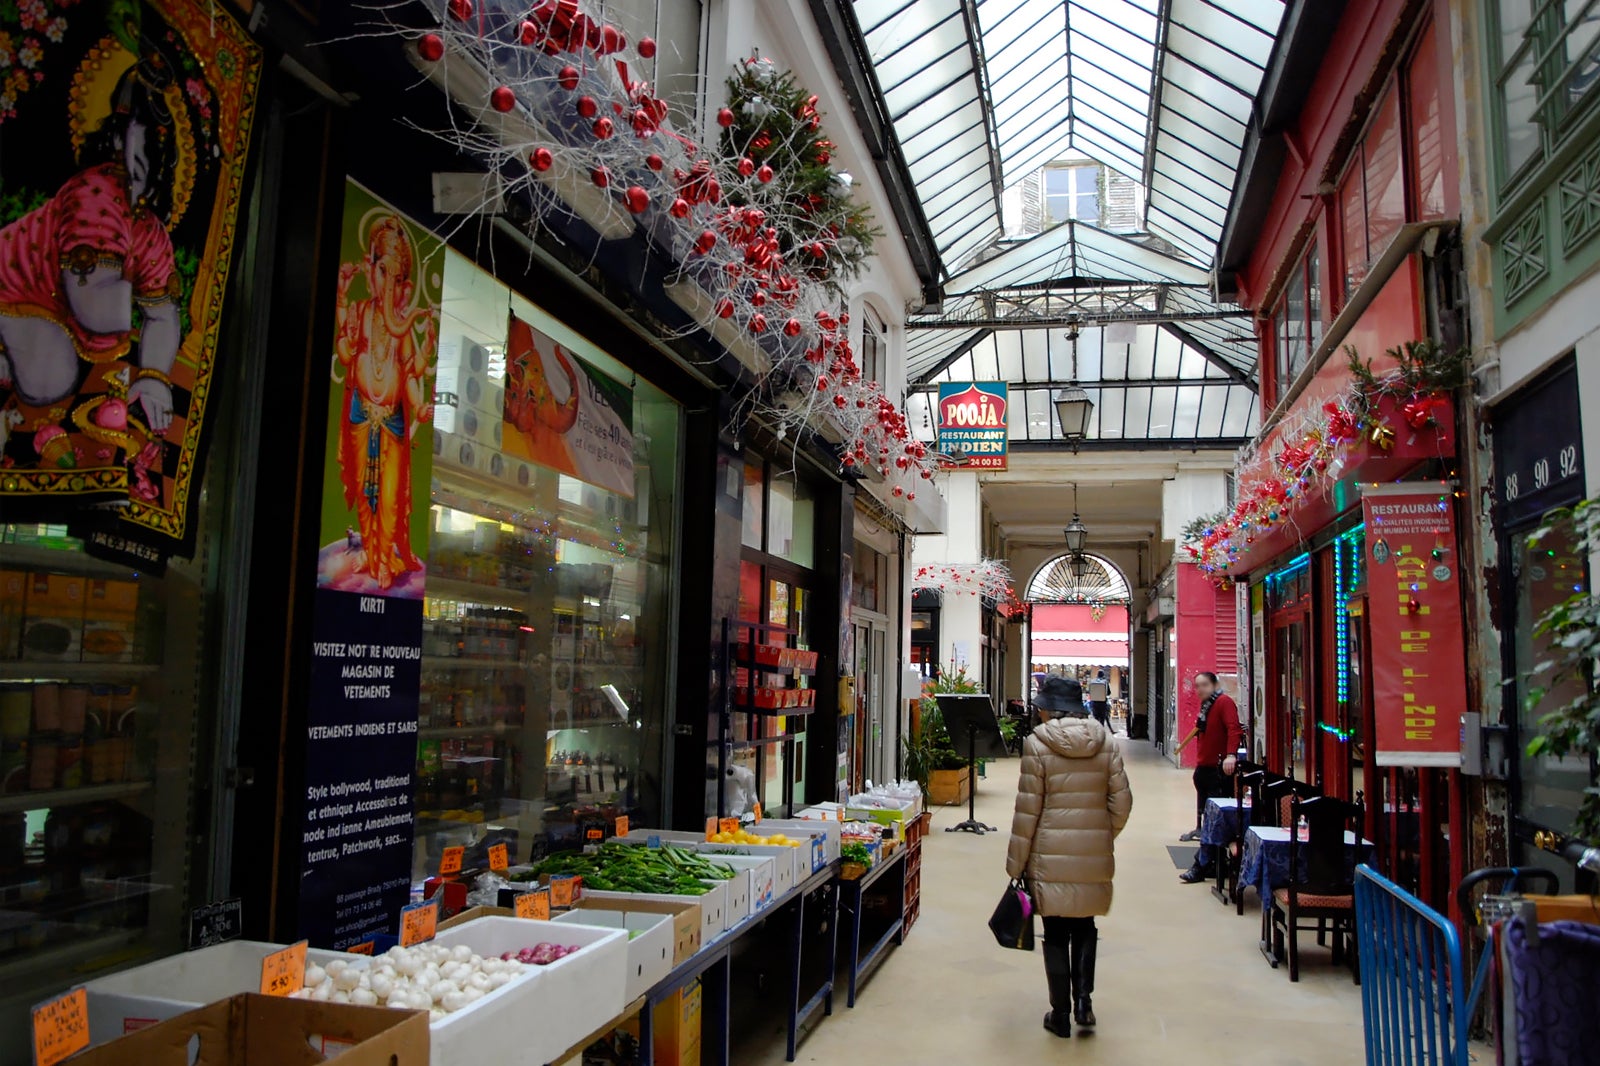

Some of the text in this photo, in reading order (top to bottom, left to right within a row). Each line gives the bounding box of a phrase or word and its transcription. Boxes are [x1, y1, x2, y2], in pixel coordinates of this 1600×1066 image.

[946, 397, 998, 426] POOJA
[608, 423, 620, 445] 40
[941, 431, 1005, 440] RESTAURANT
[940, 441, 1003, 453] INDIEN
[970, 458, 1002, 466] 24 00 83
[1506, 445, 1576, 501] 88 90 92
[1371, 504, 1449, 515] RESTAURANT
[1413, 518, 1450, 526] INDIENNES
[360, 597, 385, 614] KIRTI
[313, 642, 346, 657] VISITEZ
[382, 645, 421, 659] NOUVEAU
[1400, 631, 1431, 653] DE
[341, 665, 395, 678] MAGASIN DE
[344, 685, 391, 699] VETEMENTS
[1402, 668, 1436, 740] L'INDE
[308, 721, 418, 739] VETEMENTS INDIENS ET SARIS
[308, 785, 328, 801] Style
[330, 779, 373, 797] bollywood,
[308, 793, 408, 821] et ethnique Accessoires de
[364, 811, 414, 831] Ameublement,
[308, 847, 340, 863] tentrue,
[342, 836, 383, 856] Patchwork,
[344, 890, 366, 902] passage
